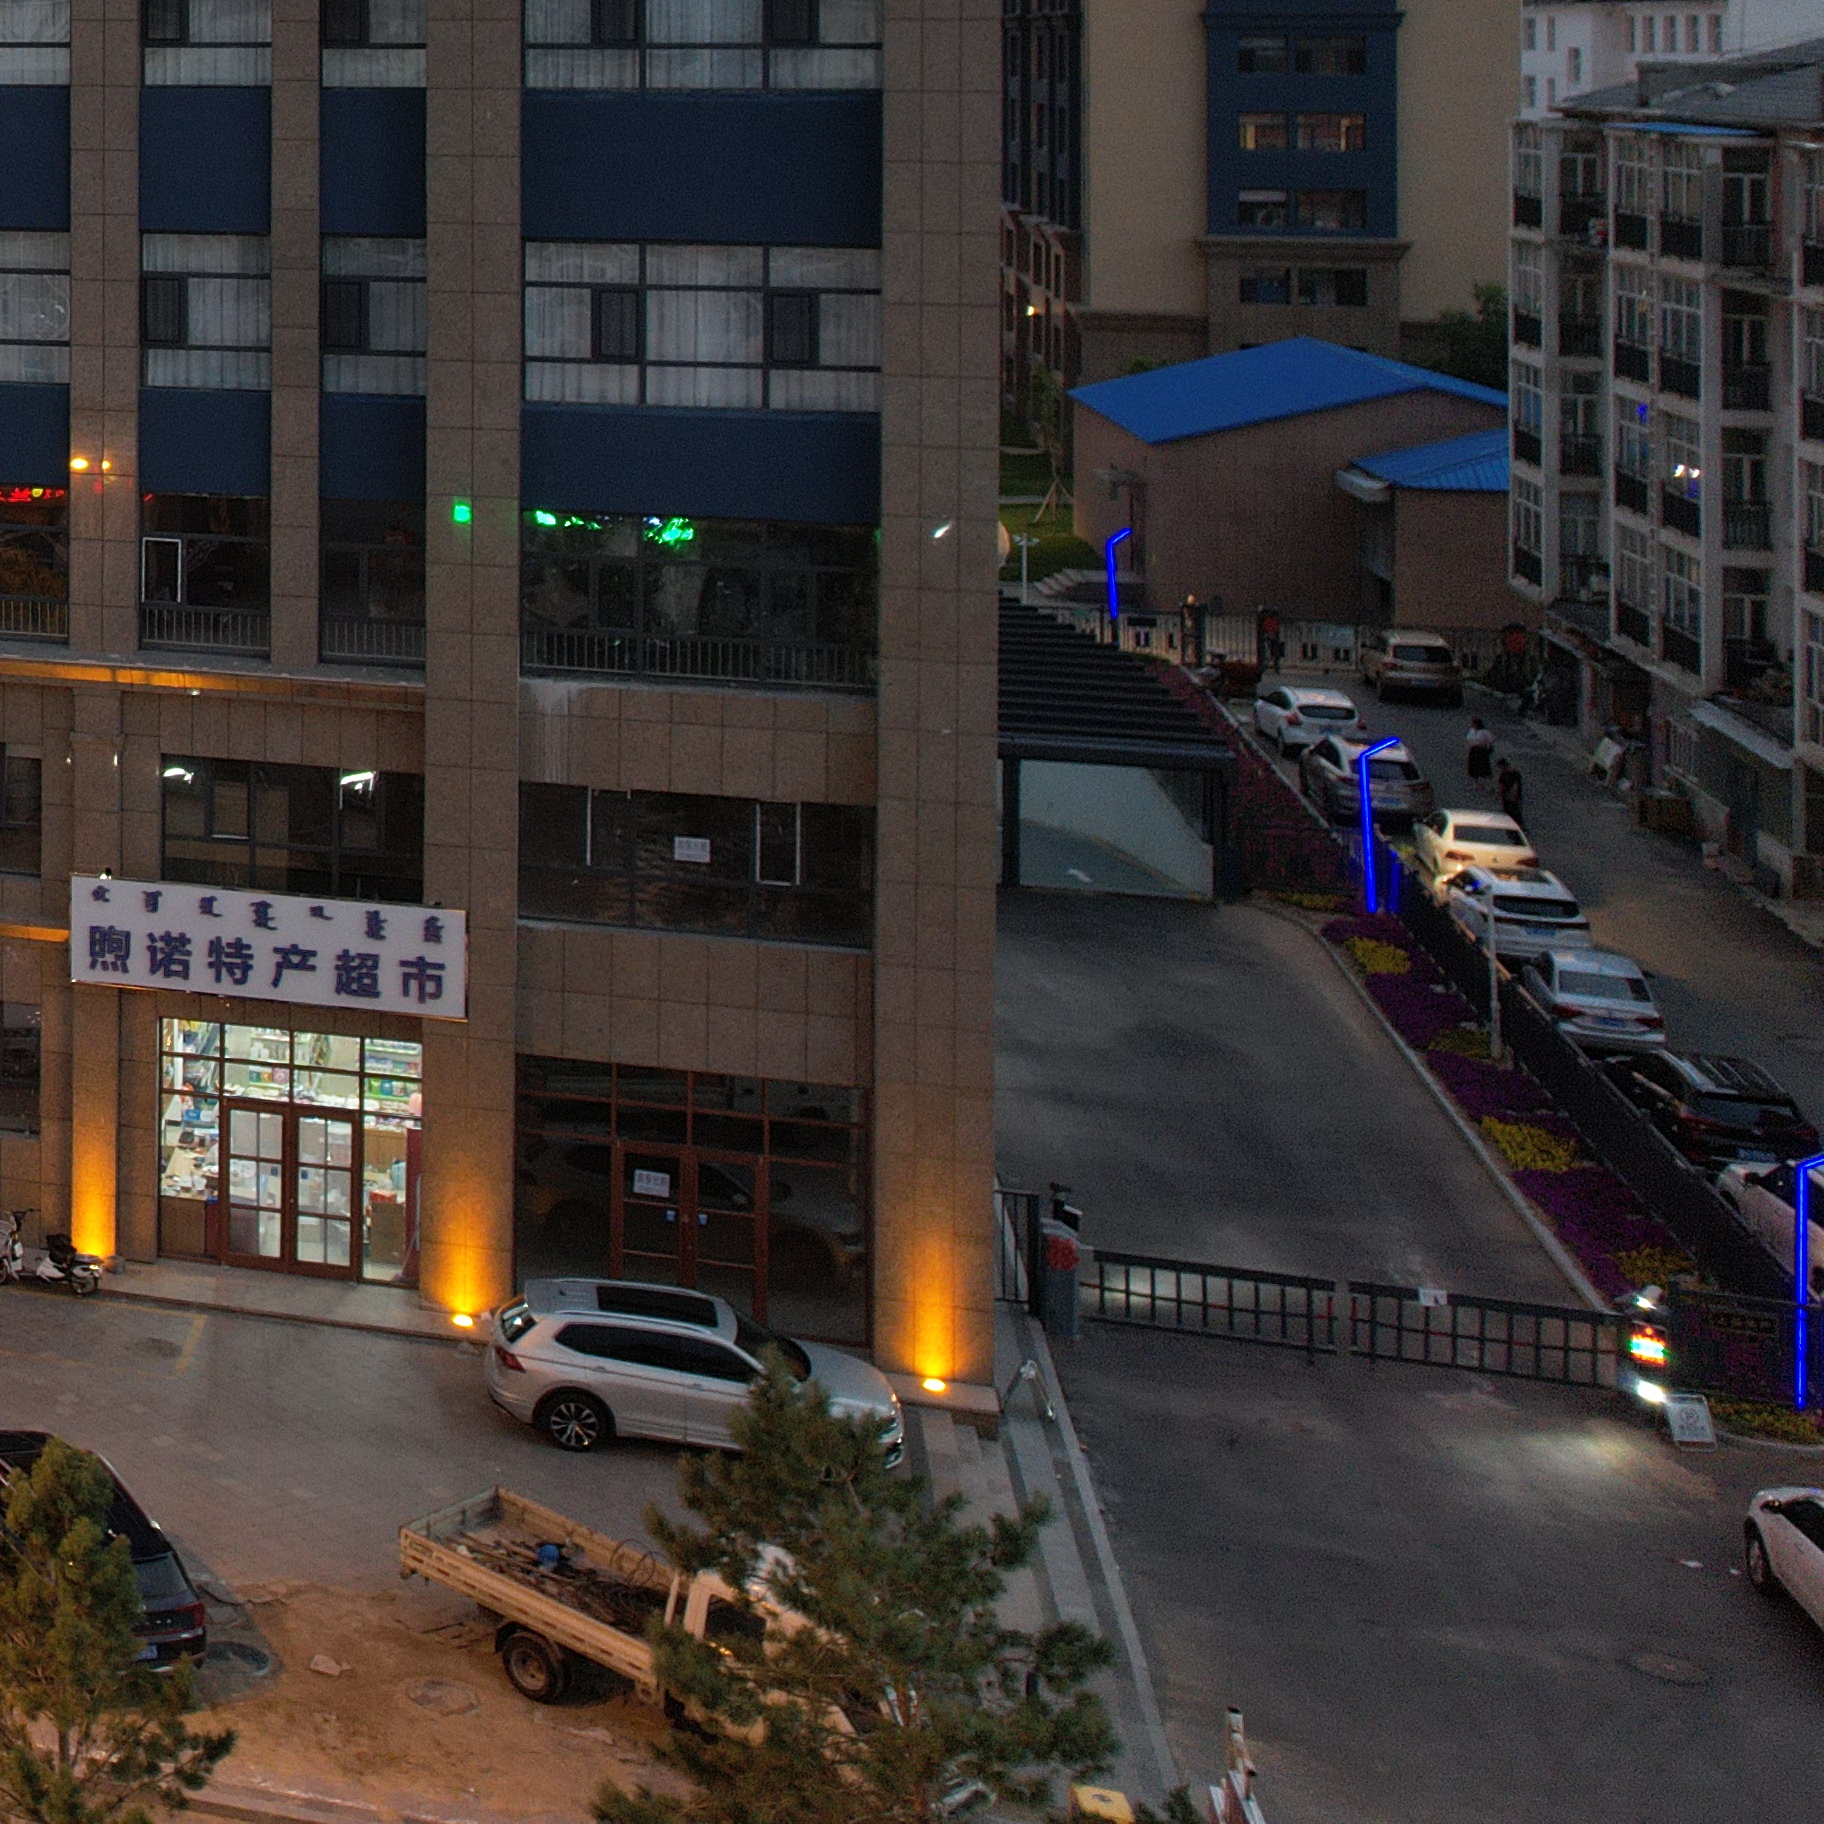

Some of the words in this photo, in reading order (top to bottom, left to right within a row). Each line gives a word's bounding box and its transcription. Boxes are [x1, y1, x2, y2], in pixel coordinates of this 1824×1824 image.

[89, 925, 446, 1005] 煦诺特产超市
